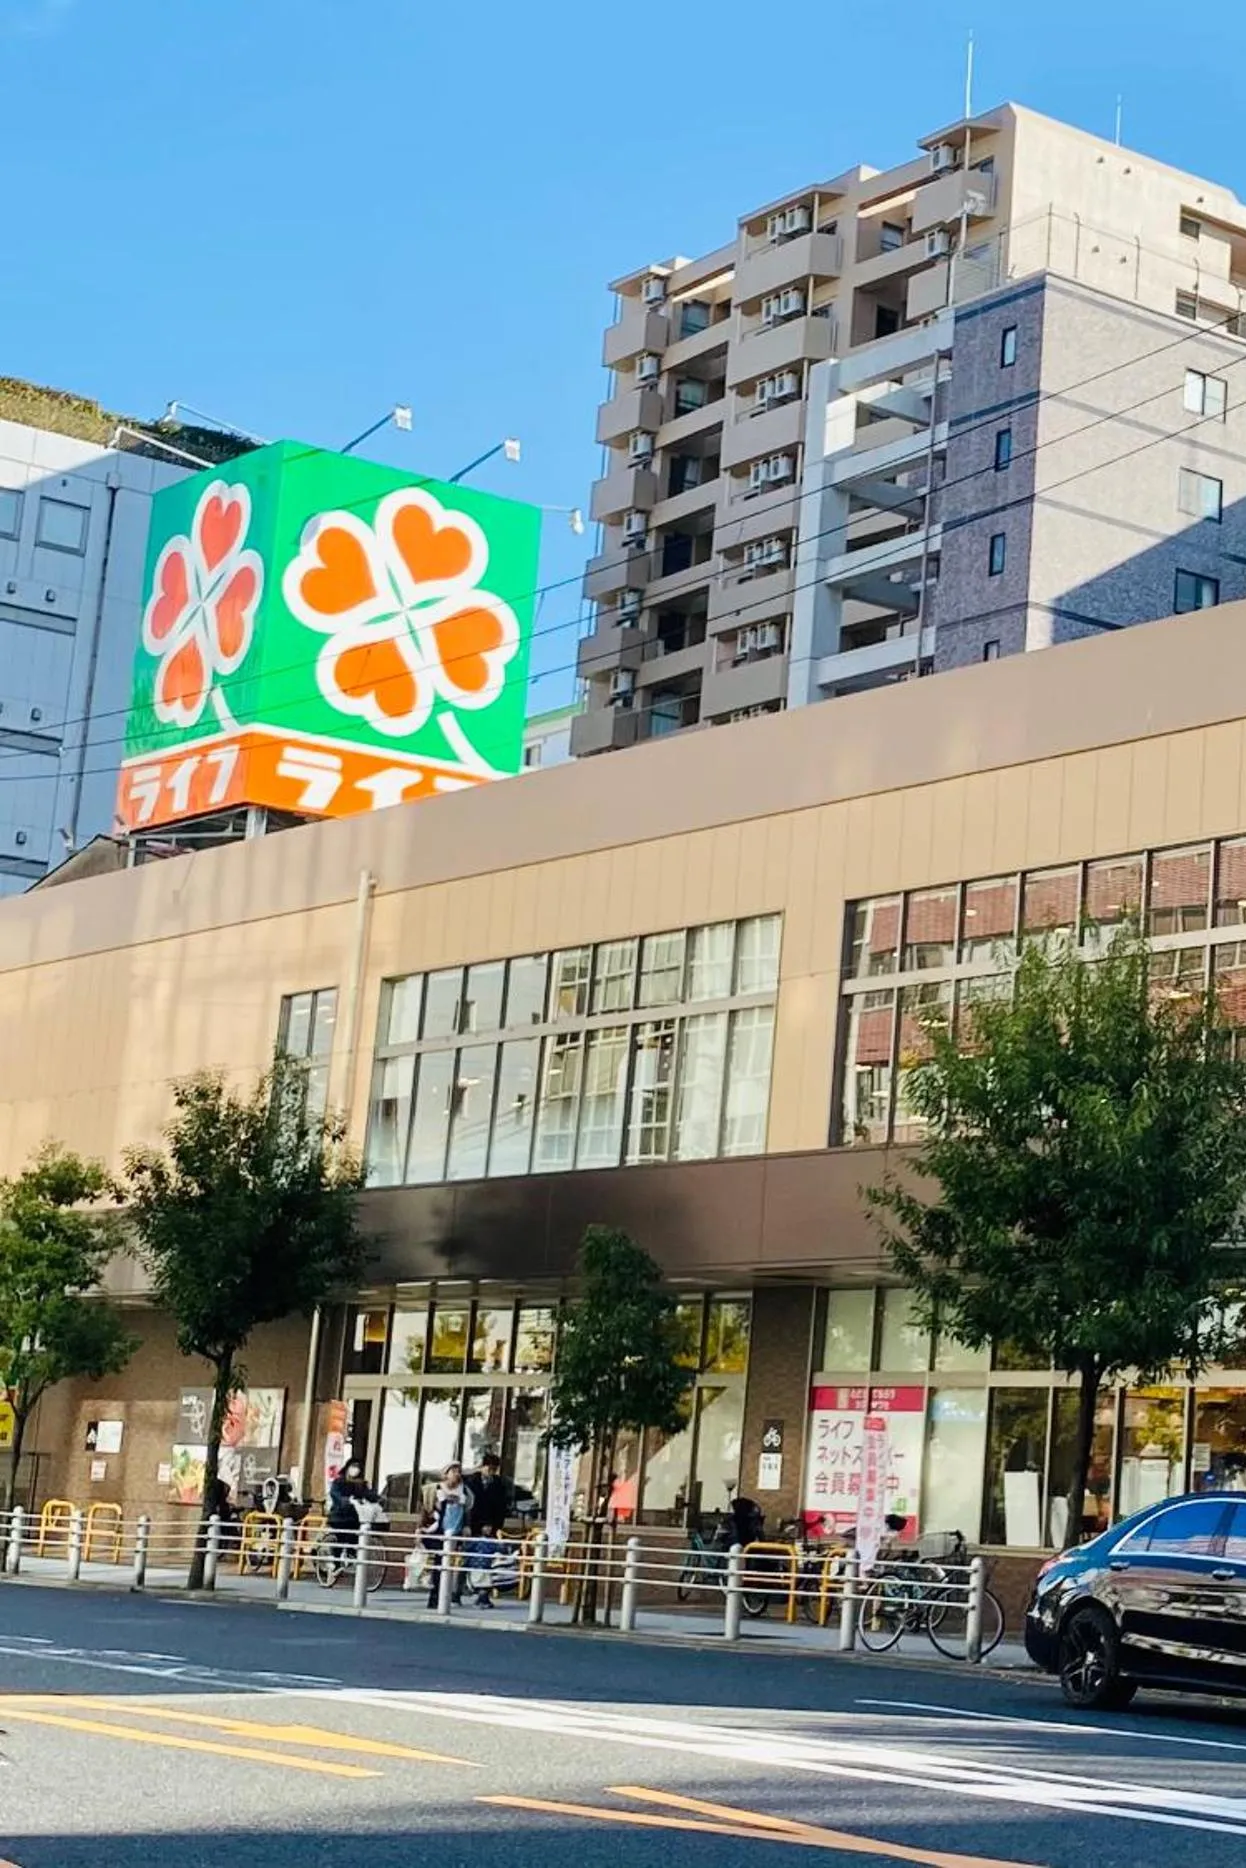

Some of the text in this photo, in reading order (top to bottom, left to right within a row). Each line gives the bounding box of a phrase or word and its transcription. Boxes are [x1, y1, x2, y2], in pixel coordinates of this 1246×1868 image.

[130, 744, 241, 823] ライフ
[276, 747, 480, 812] ライ
[818, 1418, 855, 1440] ライフ
